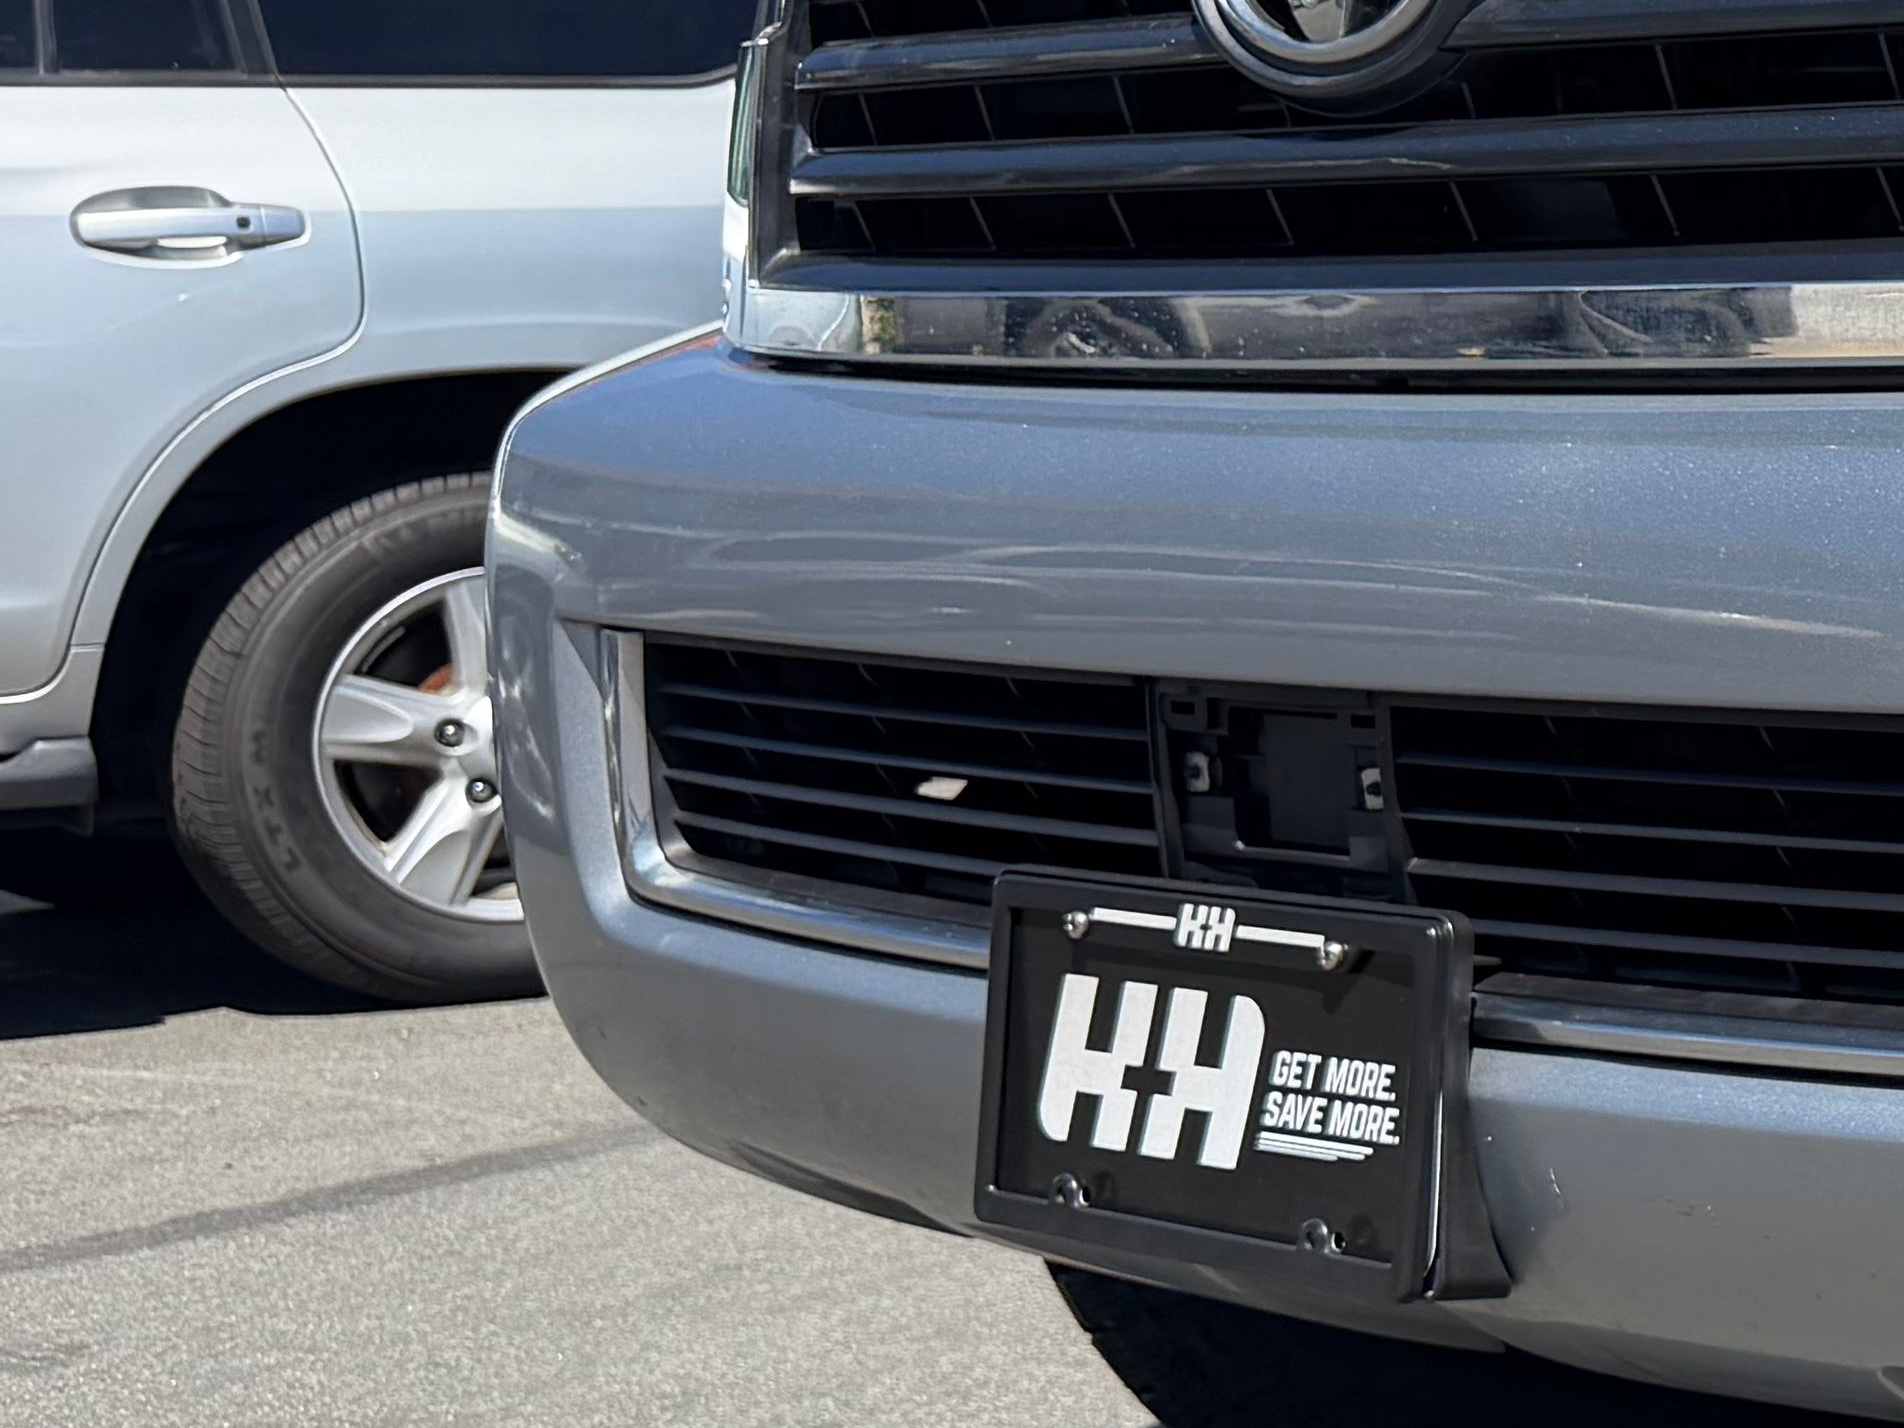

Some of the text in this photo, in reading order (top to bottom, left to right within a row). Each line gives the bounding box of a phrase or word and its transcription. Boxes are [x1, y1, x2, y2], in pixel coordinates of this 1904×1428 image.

[1269, 1050, 1396, 1102] GET MORE.
[1260, 1091, 1400, 1145] SAVE MORE.
